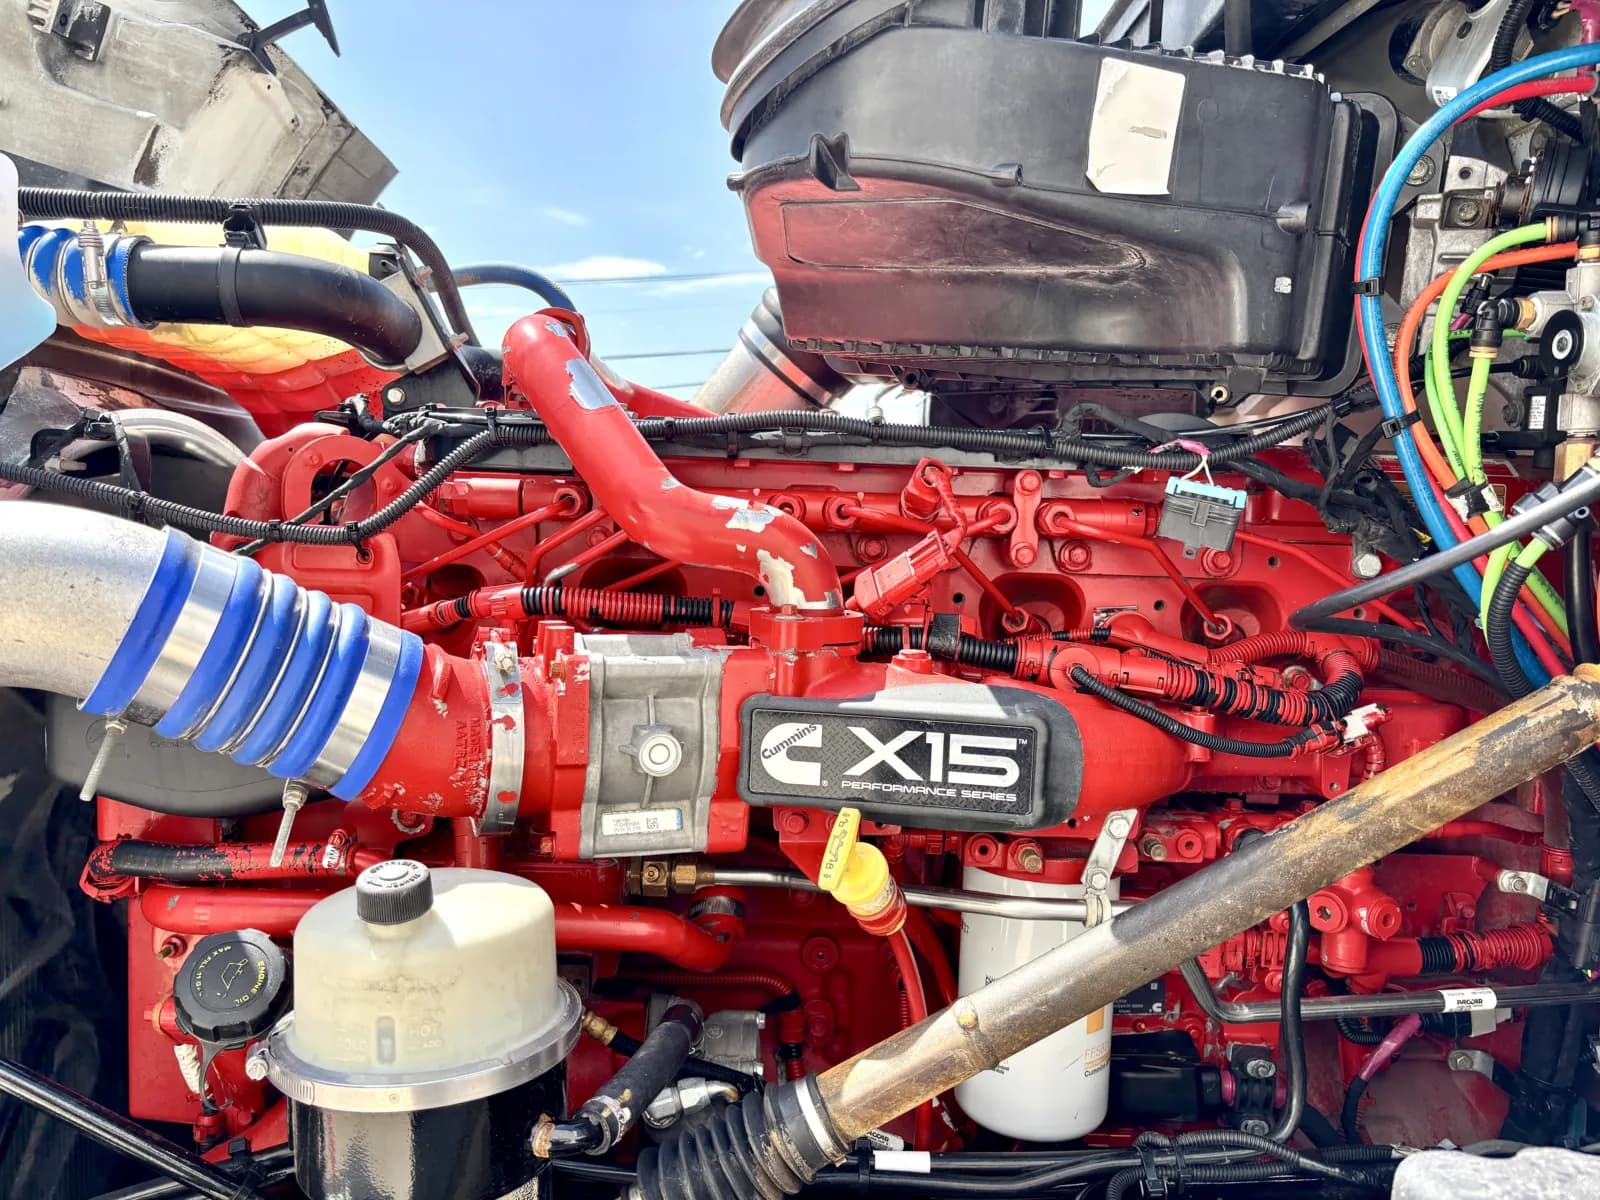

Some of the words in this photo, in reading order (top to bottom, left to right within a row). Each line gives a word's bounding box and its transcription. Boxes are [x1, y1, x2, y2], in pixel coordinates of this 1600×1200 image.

[762, 724, 817, 759] Cummins
[841, 780, 957, 797] PERFORMANCE
[961, 789, 1017, 802] SERIES
[251, 960, 267, 994] ENGINE
[867, 1130, 890, 1142] ACCAR
